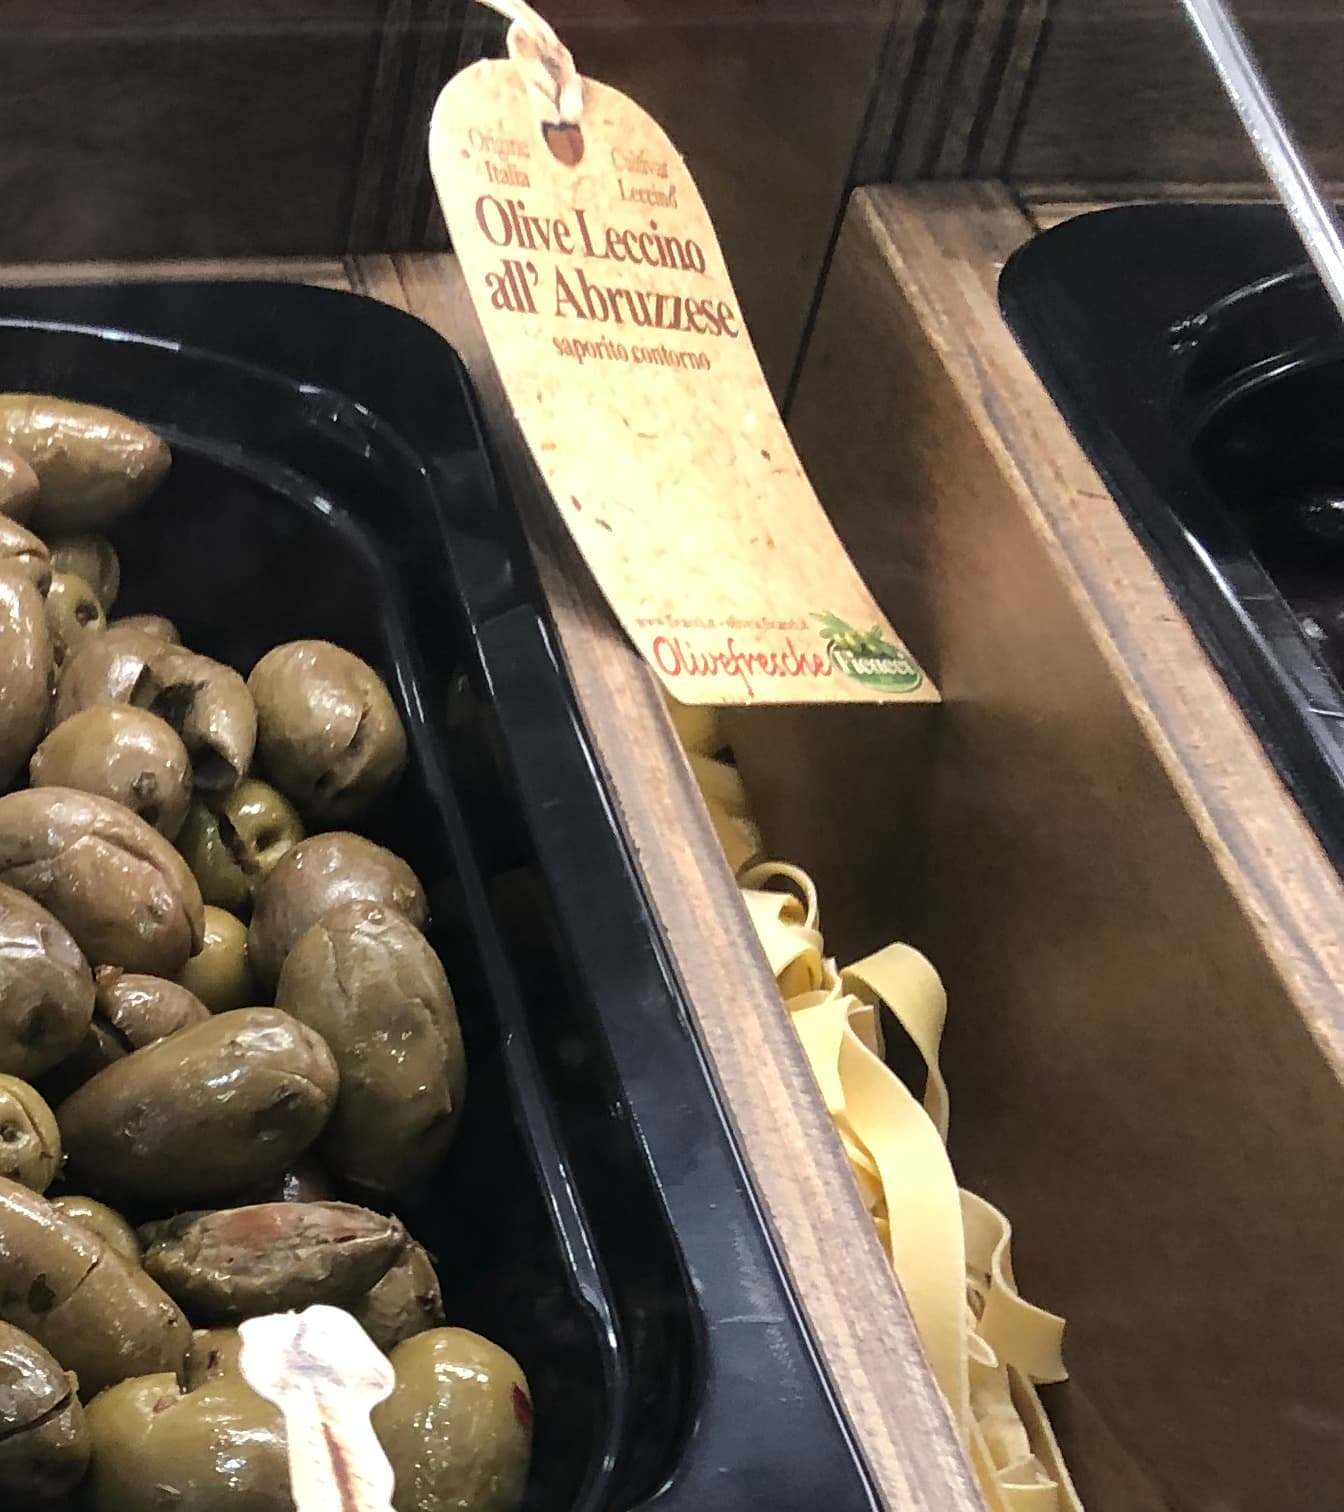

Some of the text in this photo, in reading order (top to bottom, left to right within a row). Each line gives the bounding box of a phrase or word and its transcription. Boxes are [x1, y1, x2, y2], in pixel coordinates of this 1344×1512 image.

[484, 160, 531, 188] Italia
[475, 193, 706, 275] Olive Leccino
[554, 264, 740, 339] Abruzzese
[552, 334, 712, 371] saporito contorno
[652, 634, 833, 699] Olivefresche
